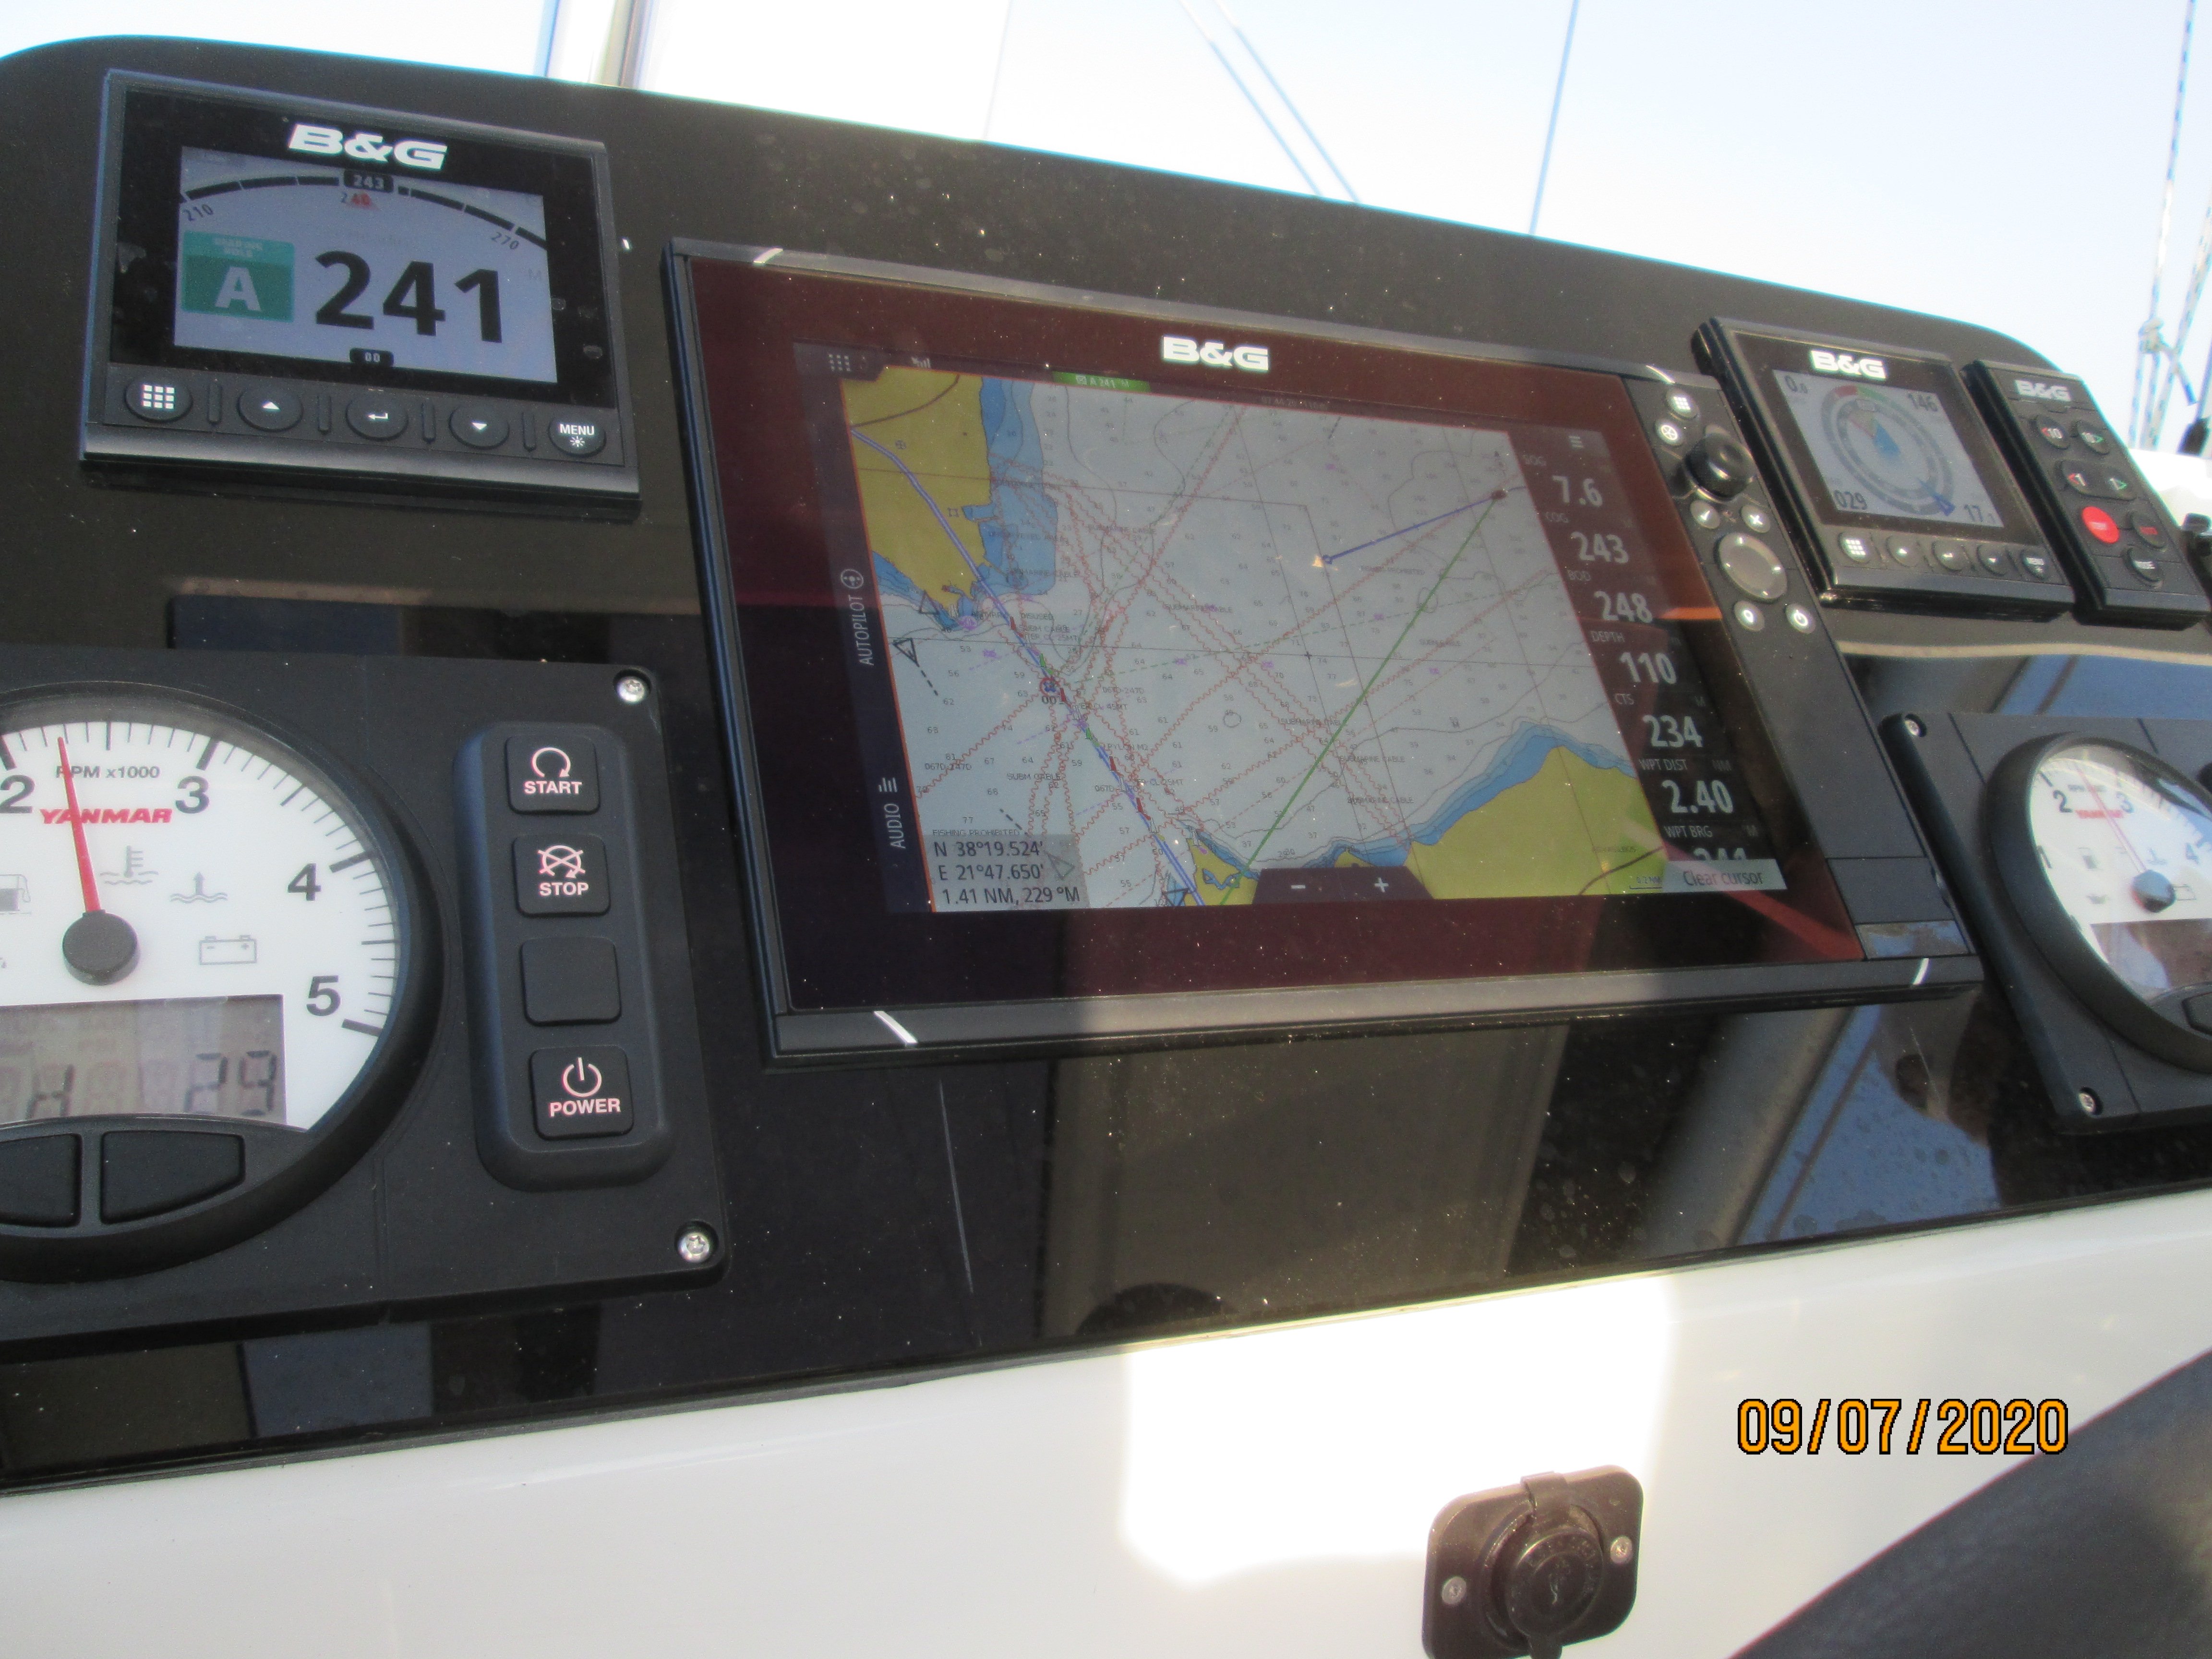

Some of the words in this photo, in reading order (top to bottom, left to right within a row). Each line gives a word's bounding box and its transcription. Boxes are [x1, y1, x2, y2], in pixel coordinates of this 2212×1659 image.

[290, 124, 448, 169] B&G
[353, 175, 384, 189] 243
[183, 204, 214, 221] 210
[491, 232, 519, 250] 270
[215, 266, 263, 311] A
[315, 251, 502, 343] 241
[1163, 336, 1269, 371] B&G
[1810, 350, 1886, 379] B&G
[2015, 380, 2071, 401] B&G
[560, 423, 595, 436] MENU
[1552, 476, 1602, 506] 7.6
[1834, 491, 1867, 510] 029
[1570, 531, 1629, 563] 243
[1594, 591, 1653, 623] 248
[848, 594, 874, 666] AUTOPILOT
[1590, 631, 1625, 642] DEPTH
[1620, 652, 1676, 684] 110
[1614, 694, 1634, 705] CTS
[1643, 715, 1703, 747] 234
[107, 767, 159, 779] x1000
[1638, 759, 1661, 771] WPT
[1664, 759, 1687, 770] DIST
[0, 774, 35, 814] 2
[176, 776, 209, 814] 3
[524, 781, 581, 795] START
[1661, 780, 1734, 814] 2.40
[2053, 790, 2073, 813] 2
[40, 808, 172, 823] YANMAR
[884, 803, 906, 849] AUDIO
[1664, 826, 1688, 837] WPT
[1691, 826, 1713, 837] BRG
[934, 842, 948, 857] N
[956, 841, 1043, 857] 38°19.524'
[288, 864, 321, 901] 4
[938, 866, 948, 880] E
[957, 865, 1043, 880] 21°47.650'
[1683, 870, 1717, 886] Clear
[1722, 872, 1763, 886] cursor
[540, 882, 589, 896] STOP
[942, 889, 977, 904] 1.41
[984, 888, 1019, 906] NM,
[1024, 887, 1053, 902] 229
[1056, 887, 1080, 902] °M
[306, 975, 340, 1016] 5
[550, 1099, 620, 1116] POWER
